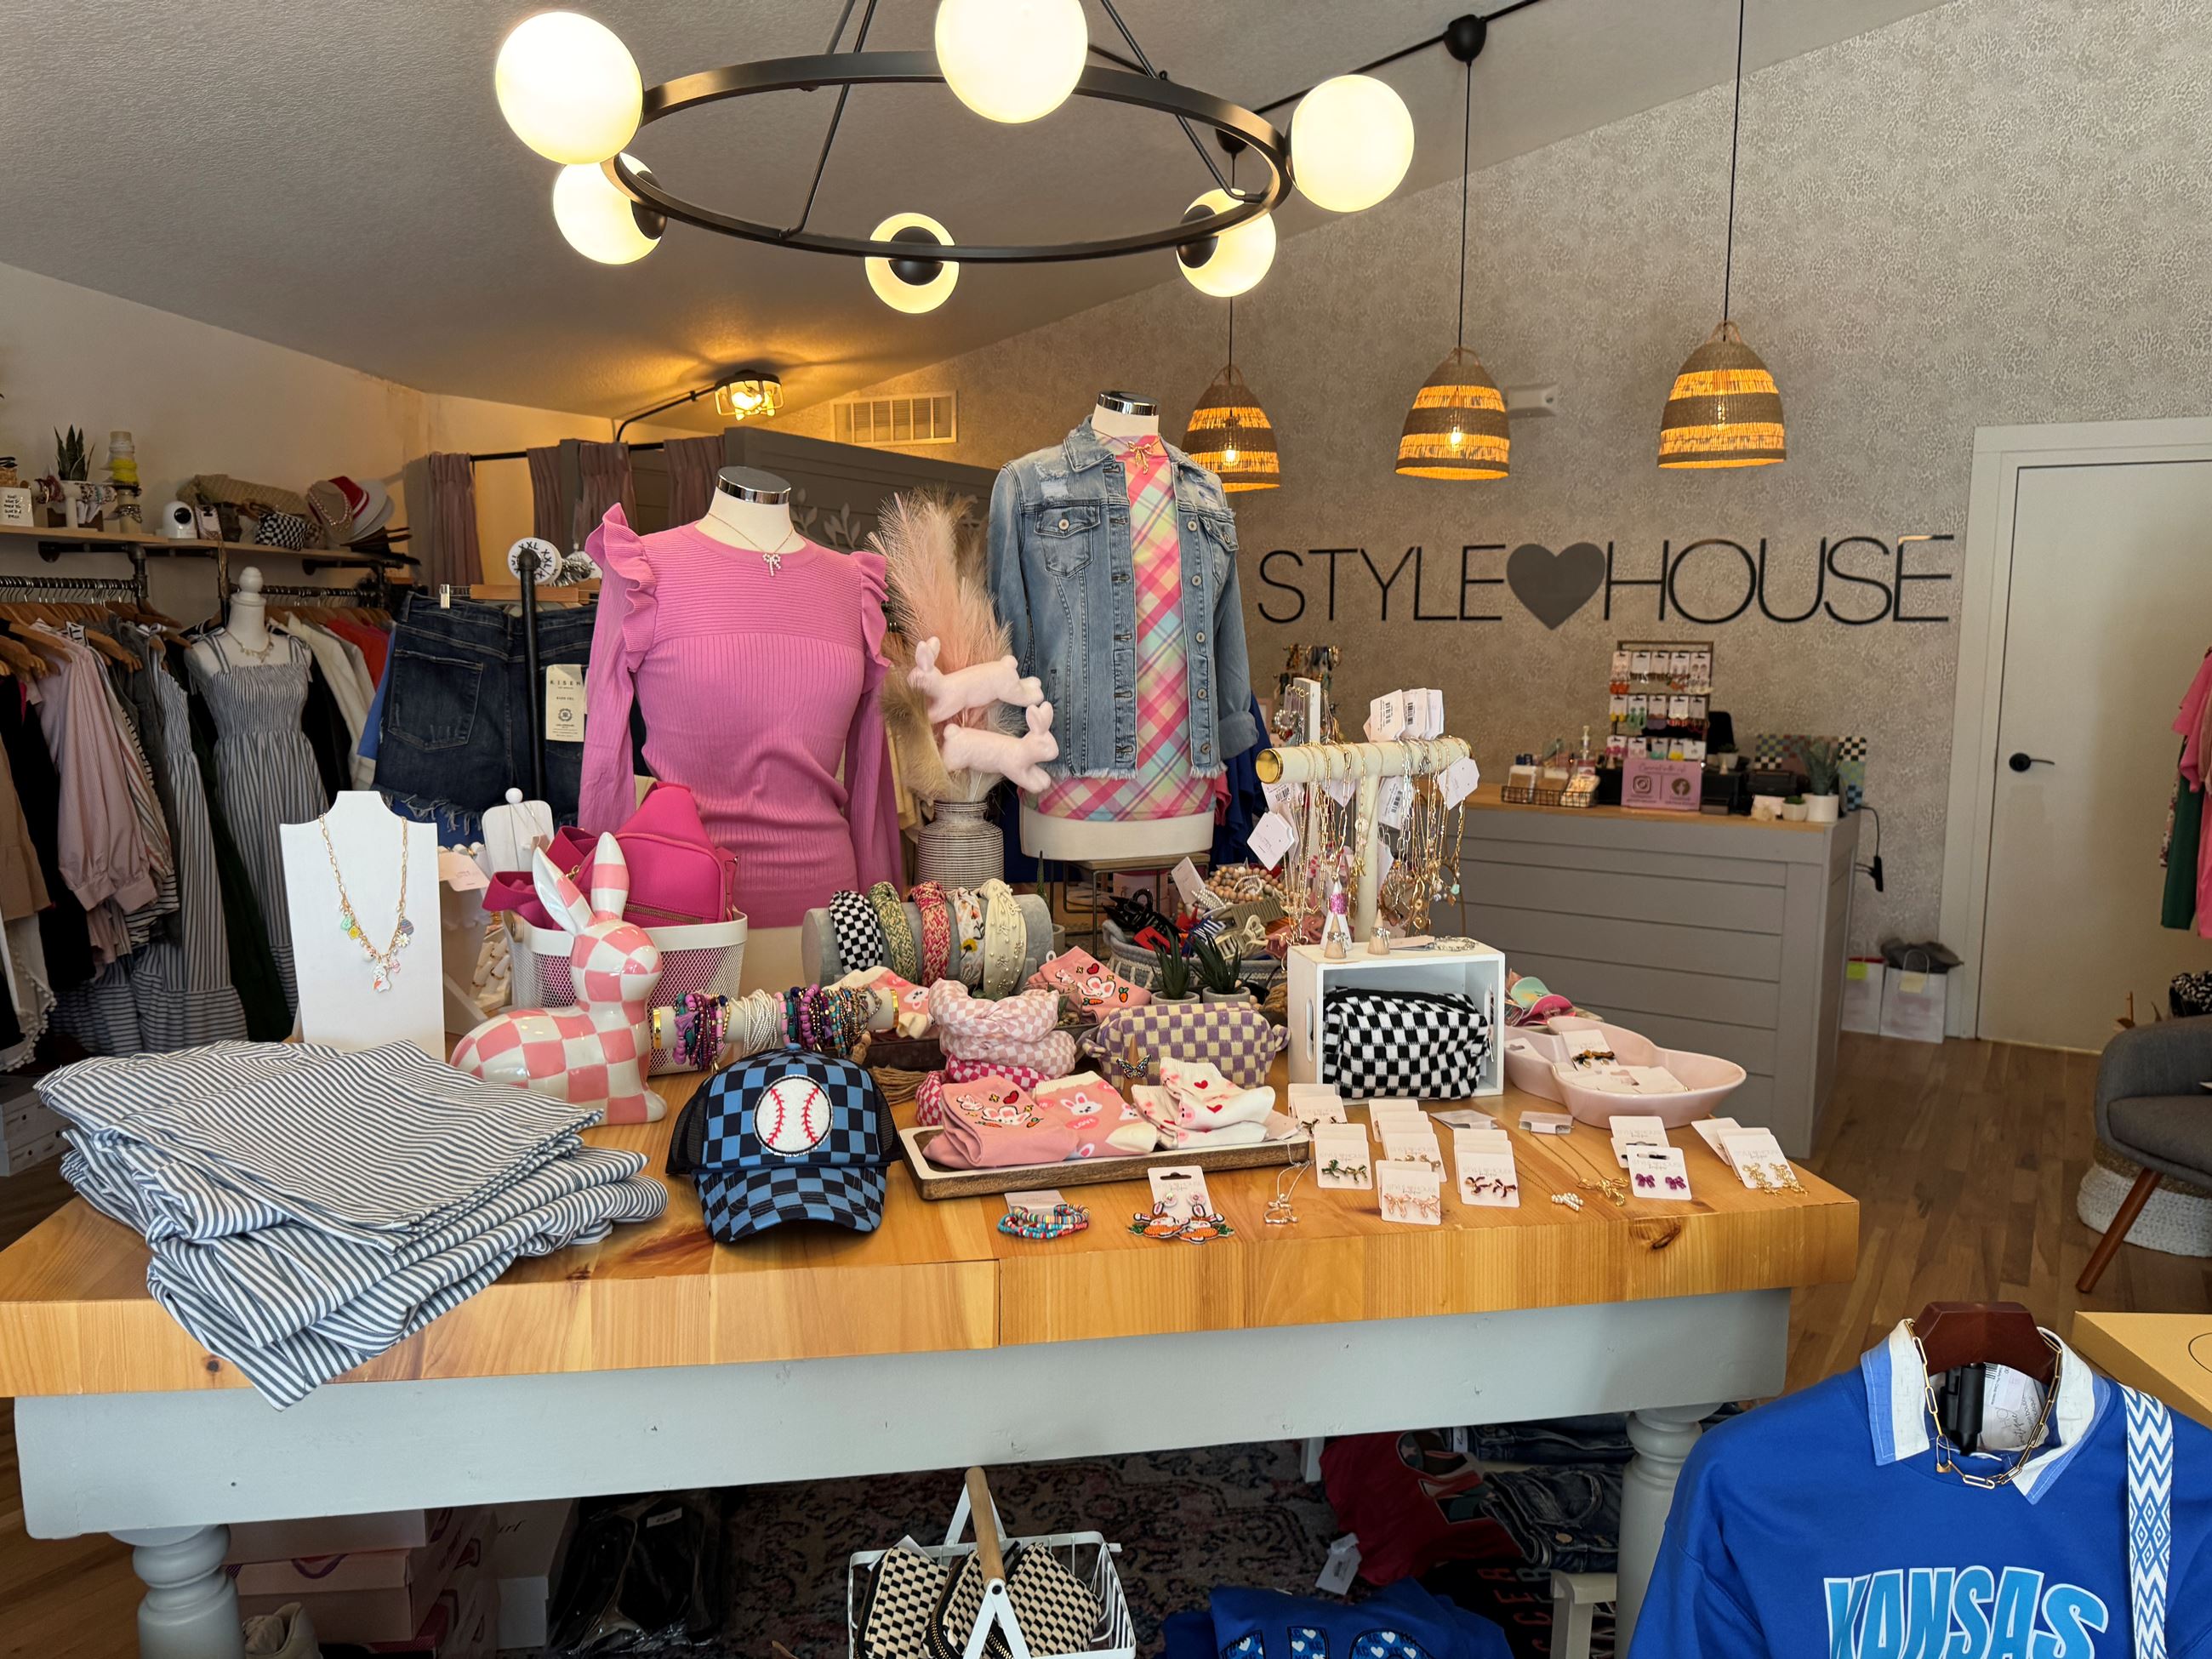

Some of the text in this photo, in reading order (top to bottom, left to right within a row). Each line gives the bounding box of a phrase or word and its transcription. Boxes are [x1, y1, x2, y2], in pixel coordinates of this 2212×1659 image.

[1257, 533, 1955, 626] STYLE HOUSE
[1823, 1565, 2109, 1659] KANSAS
